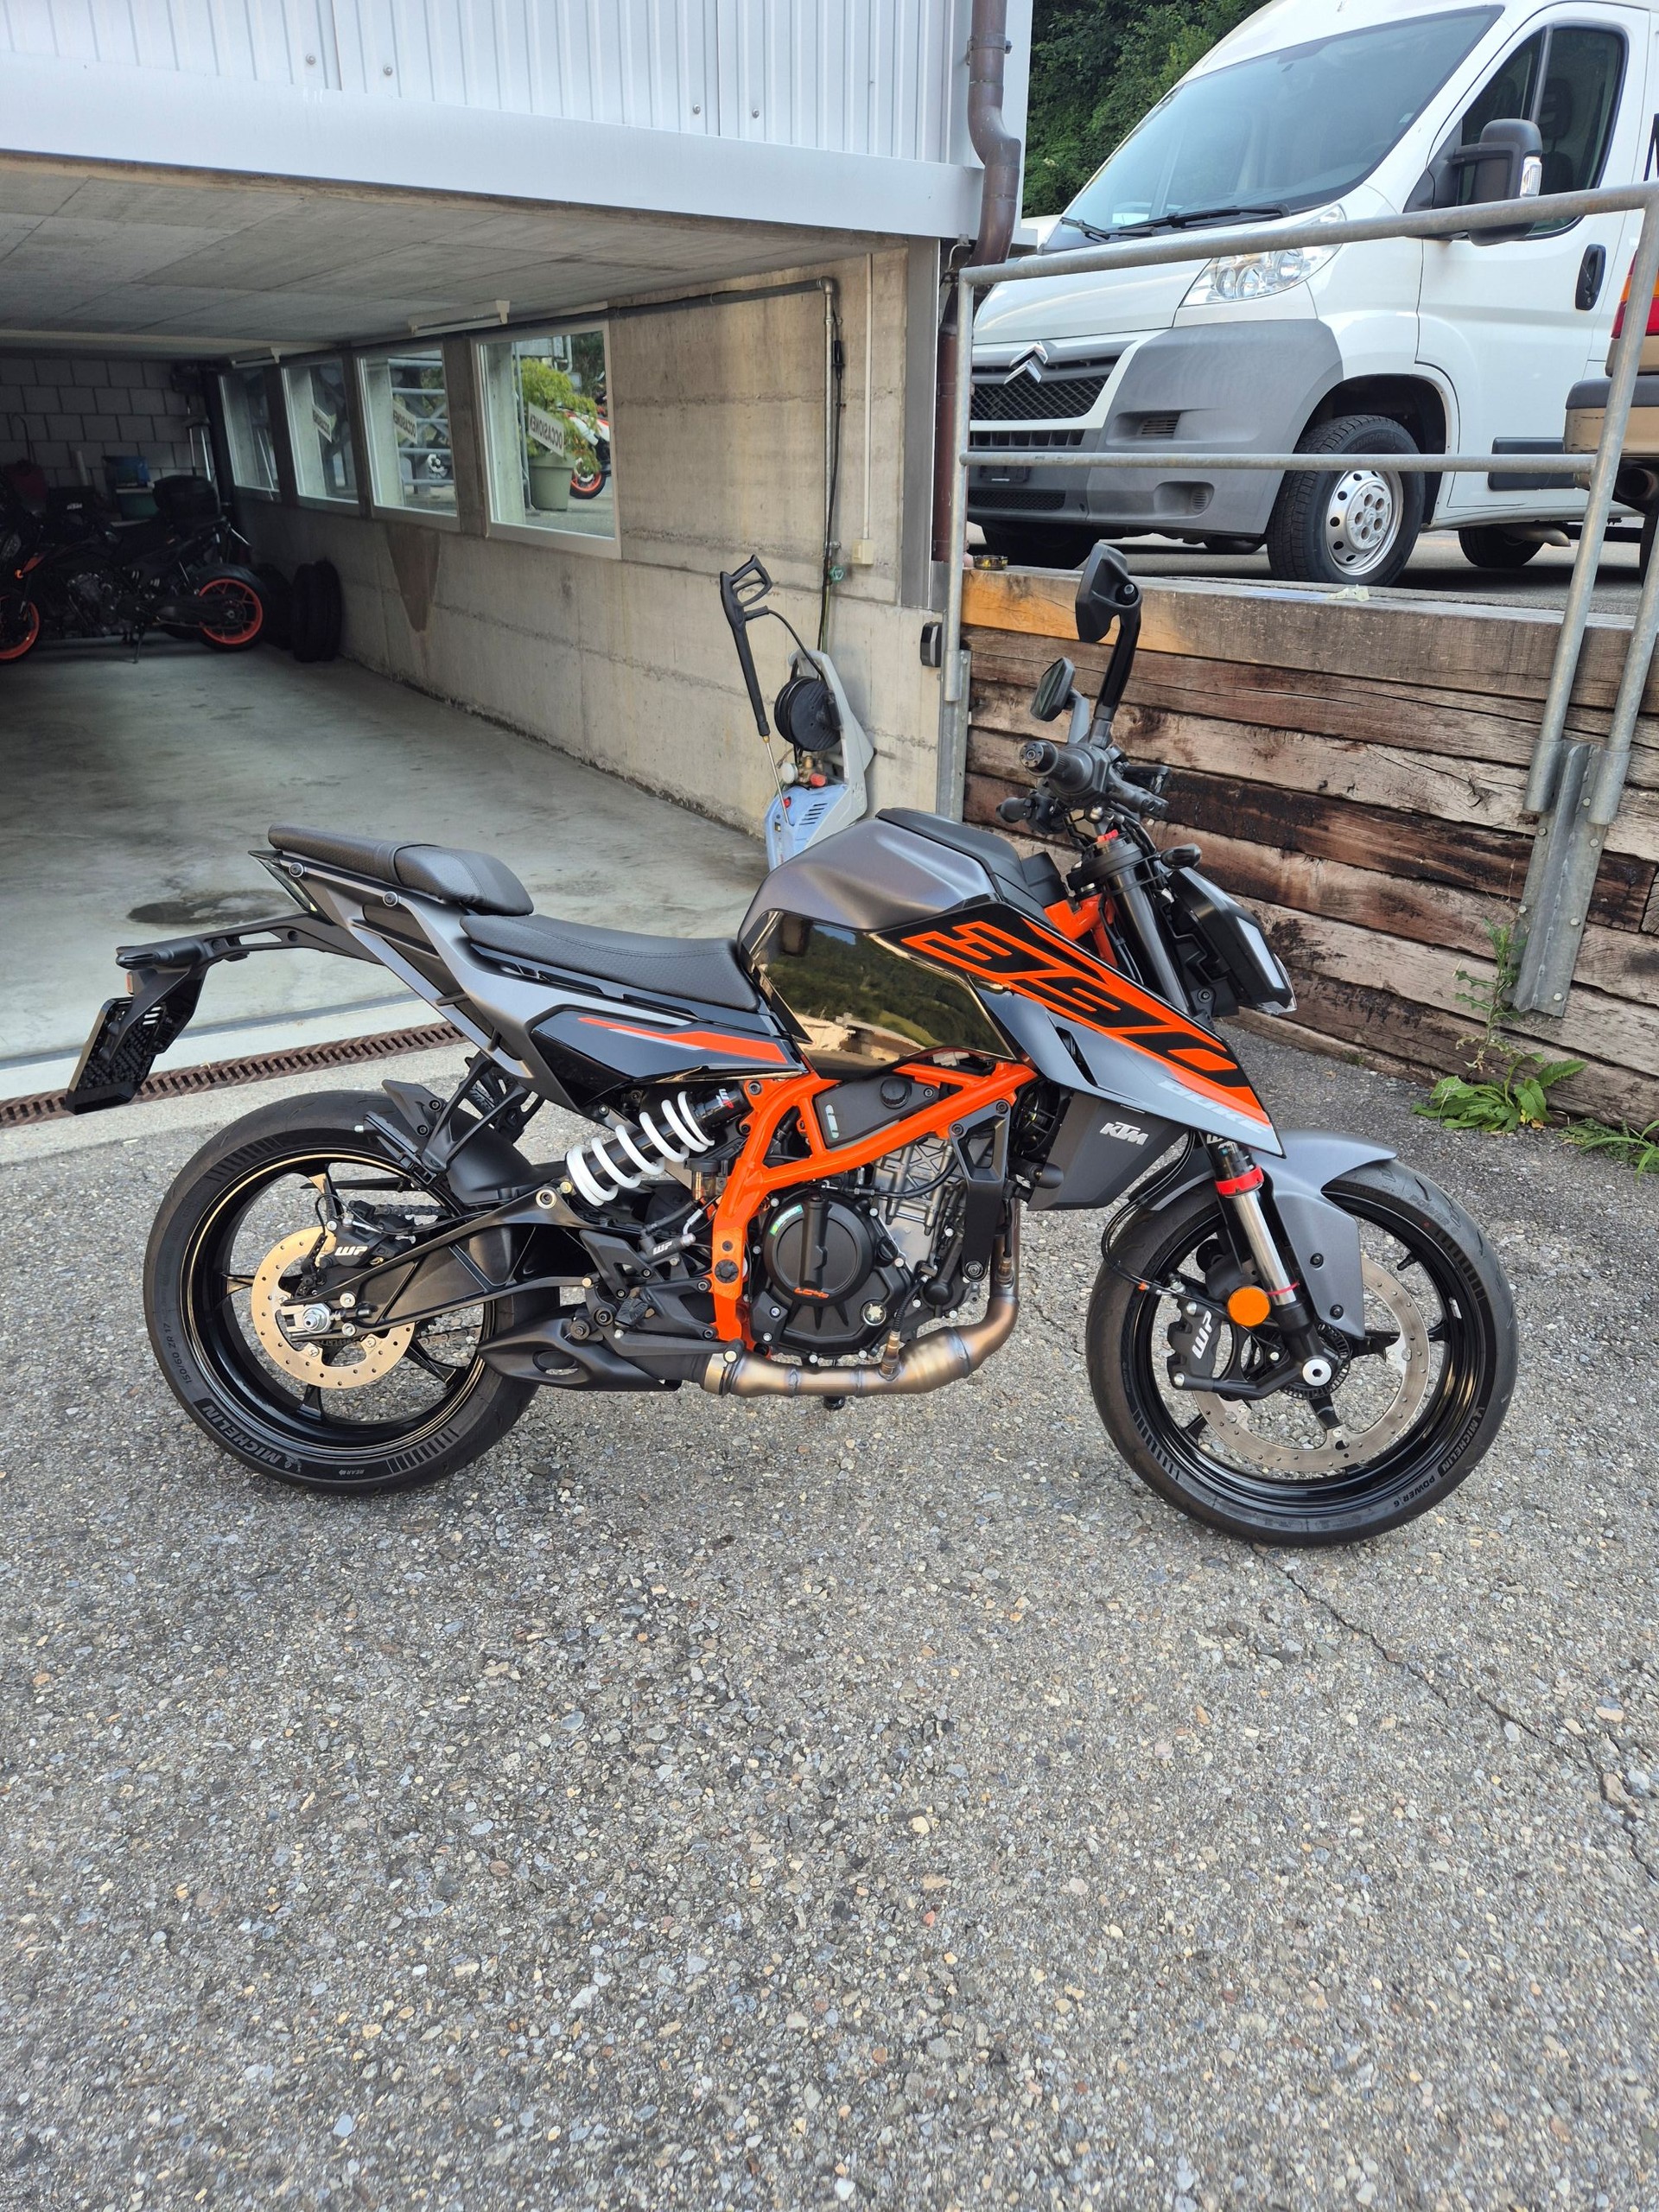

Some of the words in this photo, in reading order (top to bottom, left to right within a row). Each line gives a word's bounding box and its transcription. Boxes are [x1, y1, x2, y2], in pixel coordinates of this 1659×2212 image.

[923, 923, 1250, 1087] 390
[1156, 1080, 1268, 1134] DUKE
[1100, 1122, 1149, 1146] KTM
[334, 1246, 368, 1255] WP
[653, 1241, 673, 1255] WP
[1192, 1310, 1212, 1359] WP
[173, 1351, 192, 1383] 150/60
[202, 1404, 283, 1465] MICHELIN
[1441, 1419, 1478, 1471] MICHELIN
[1403, 1475, 1435, 1503] POWER
